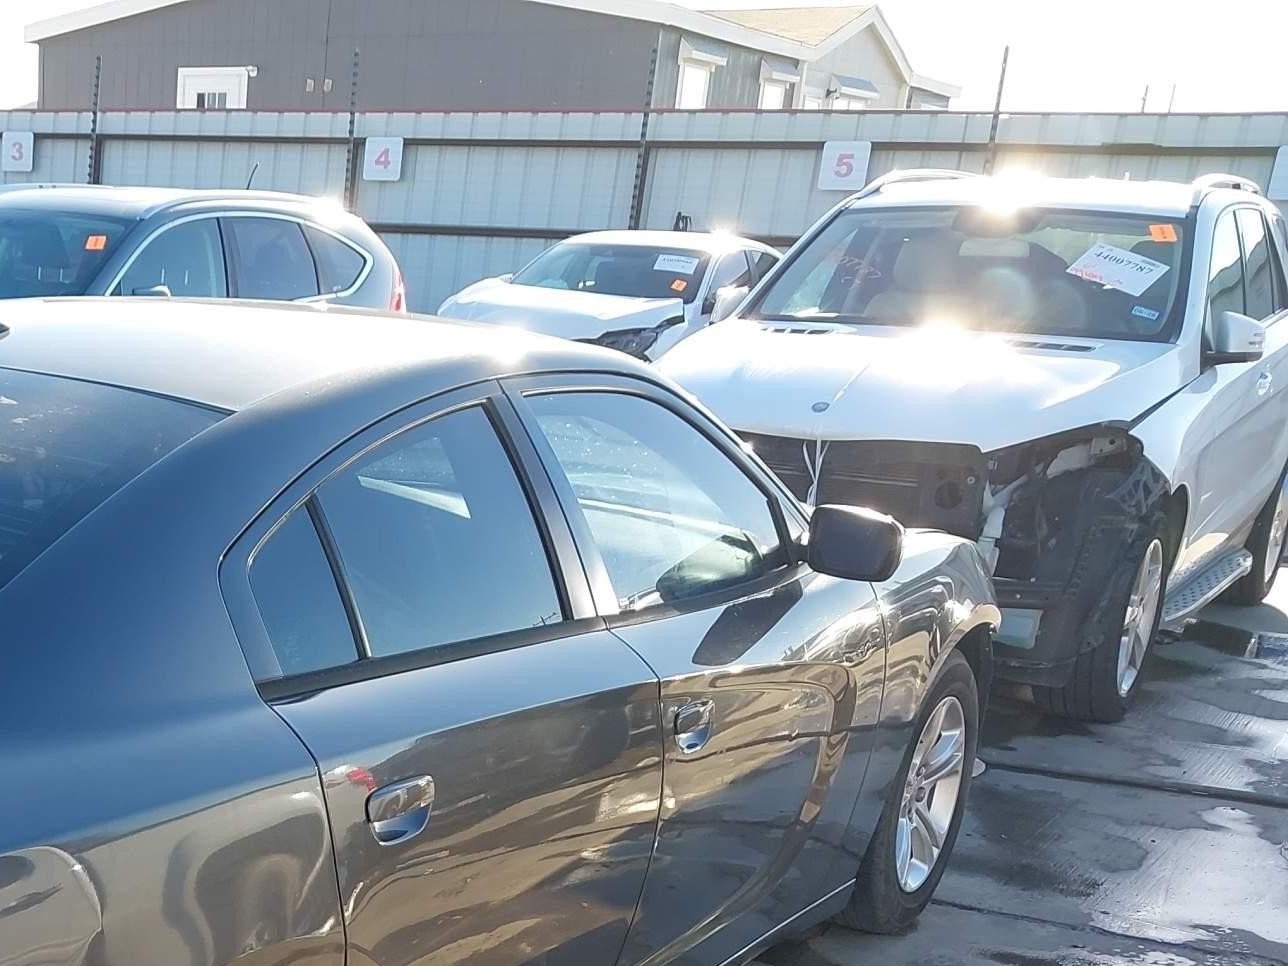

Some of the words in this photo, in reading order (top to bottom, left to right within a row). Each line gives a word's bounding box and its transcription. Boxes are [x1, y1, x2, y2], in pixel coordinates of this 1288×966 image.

[9, 141, 25, 162] 3
[374, 147, 391, 169] 4
[834, 152, 855, 178] 5
